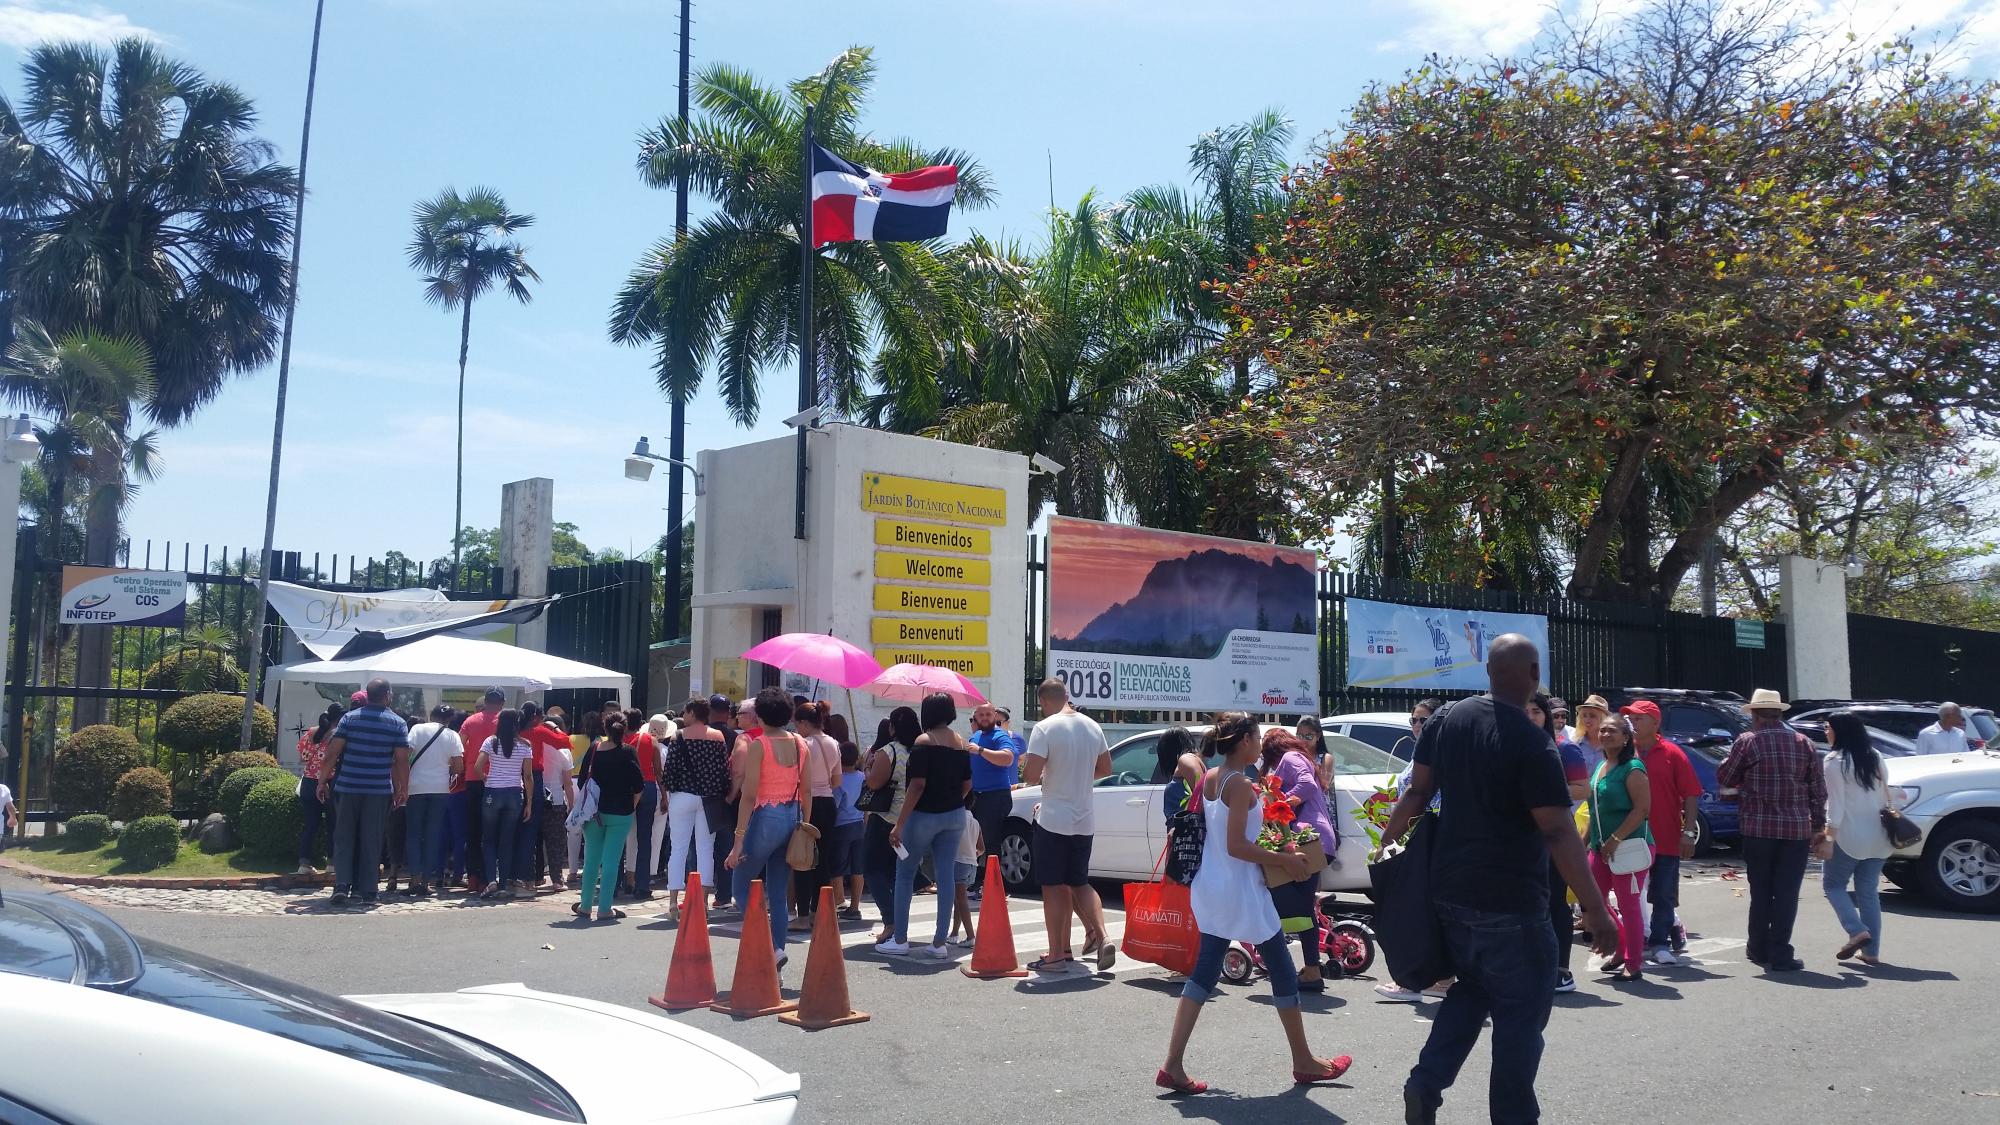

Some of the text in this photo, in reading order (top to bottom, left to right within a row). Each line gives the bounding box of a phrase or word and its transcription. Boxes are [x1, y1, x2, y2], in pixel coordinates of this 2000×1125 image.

[868, 490, 903, 507] JARDÍN
[906, 494, 954, 513] BOTÁNICO
[957, 501, 1003, 519] NACIONAL
[896, 526, 972, 548] Bienvenidos
[906, 559, 963, 579] Welcome
[113, 576, 182, 587] Centro Operativo
[123, 585, 171, 595] del Sistema
[135, 595, 159, 606] COS
[901, 591, 967, 610] Bienvenue
[66, 609, 116, 620] INFOTEP
[900, 624, 963, 641] Benvenuti
[1056, 658, 1111, 670] SERIE ECOLÓGICA
[1435, 656, 1453, 667] Años
[1120, 662, 1191, 680] MONTAÑAS &
[1056, 669, 1112, 699] 2018
[1120, 677, 1191, 693] ELEVACIONES
[1262, 692, 1289, 707] Popular
